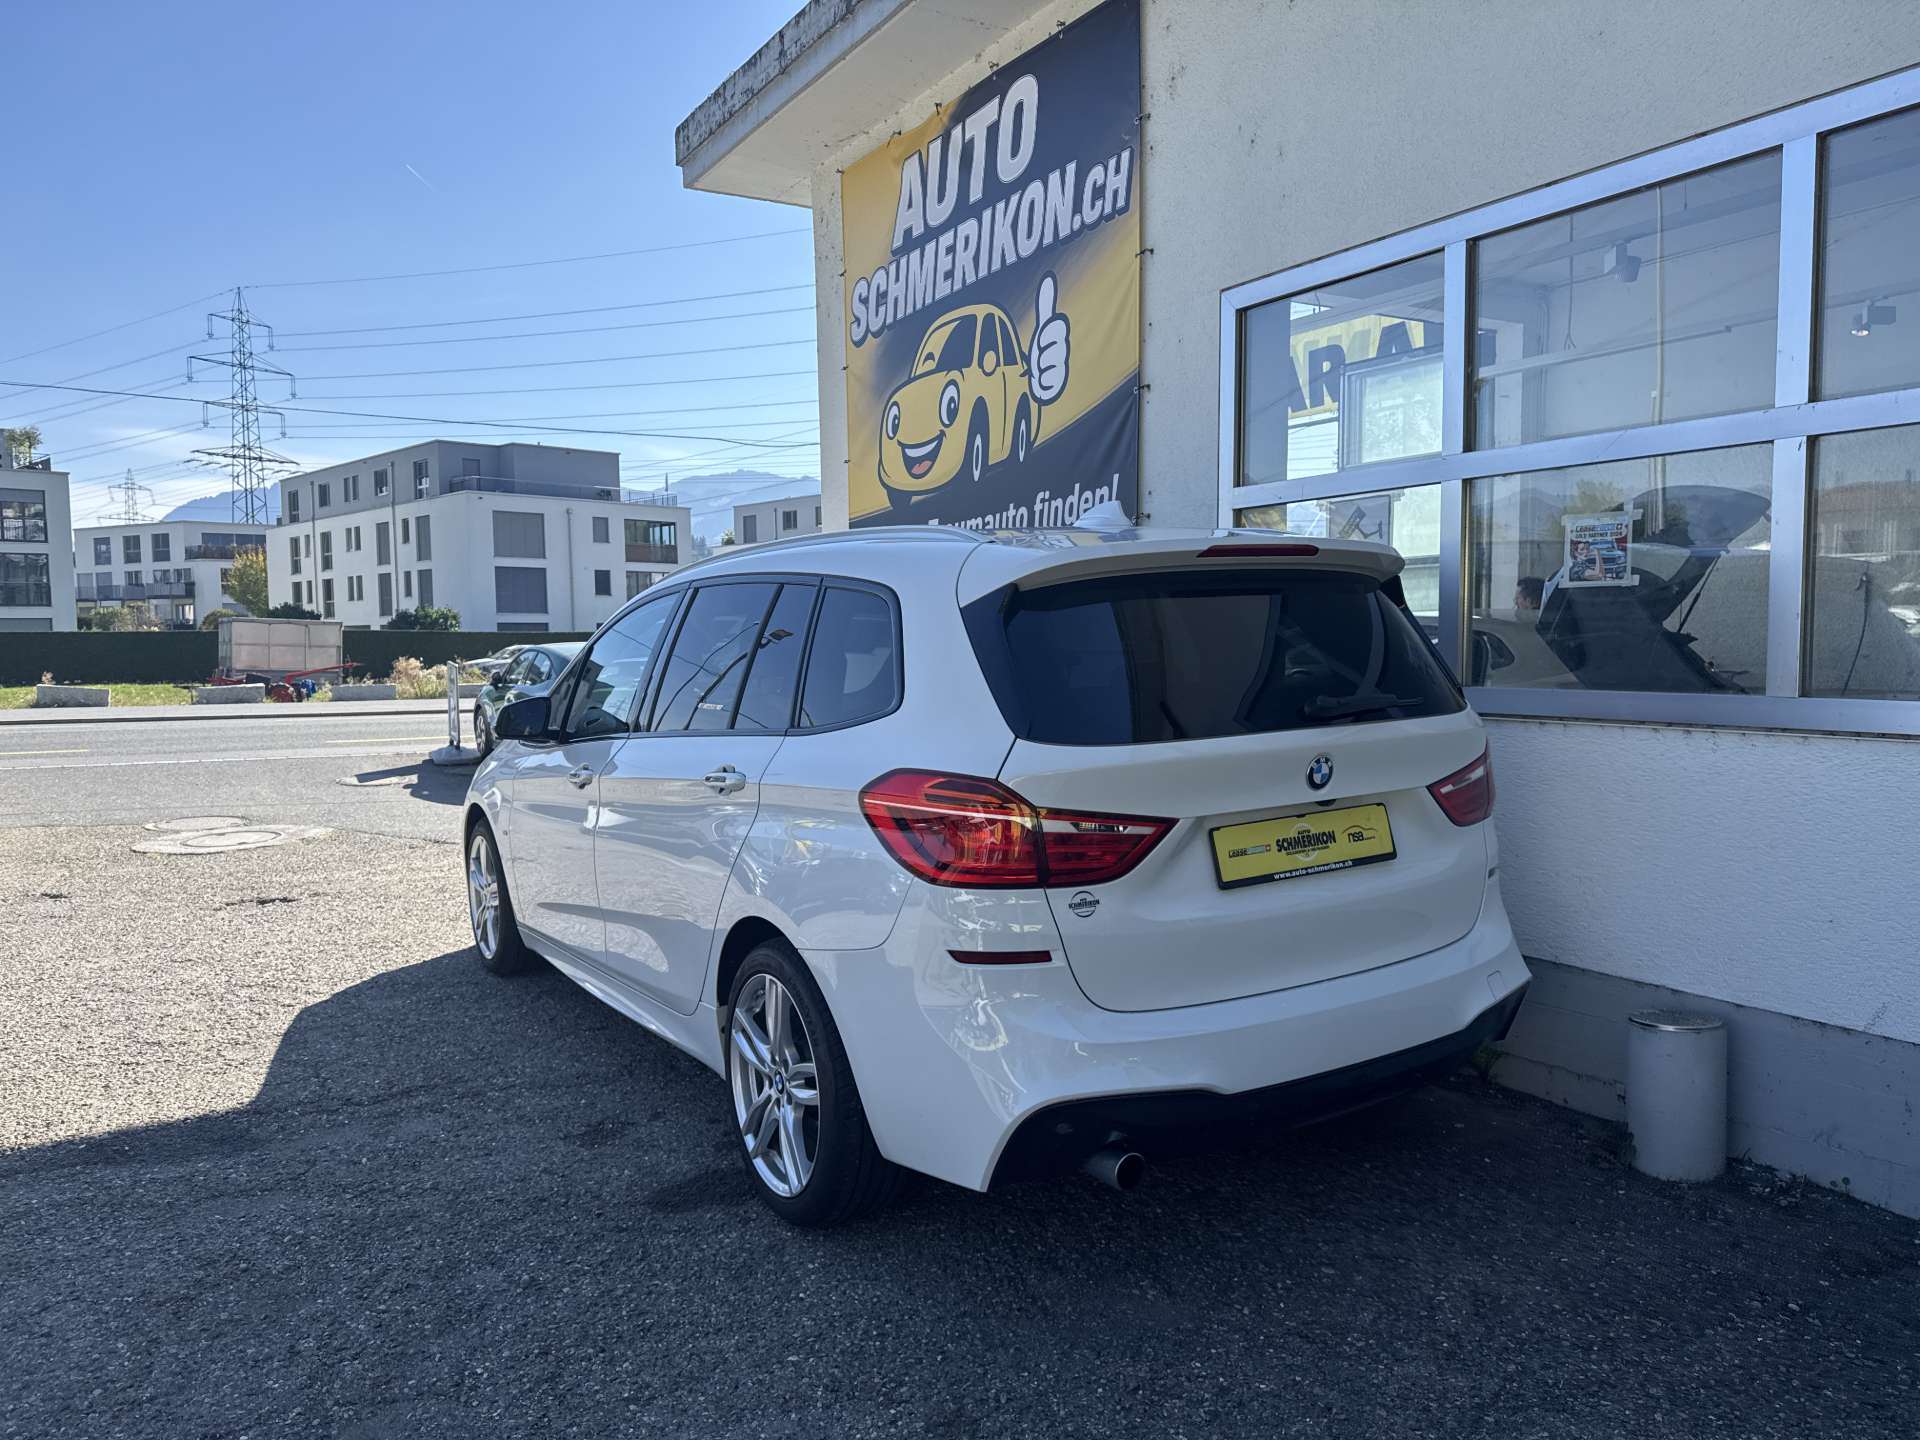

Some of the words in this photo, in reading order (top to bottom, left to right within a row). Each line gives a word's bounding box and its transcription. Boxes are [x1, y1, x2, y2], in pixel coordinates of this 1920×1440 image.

[892, 73, 1039, 250] AUTO
[850, 147, 1132, 344] SCHMERIKON.CH
[1273, 860, 1353, 880] www.auto-schmerikon.ch
[1275, 830, 1337, 853] SCHMERIKON
